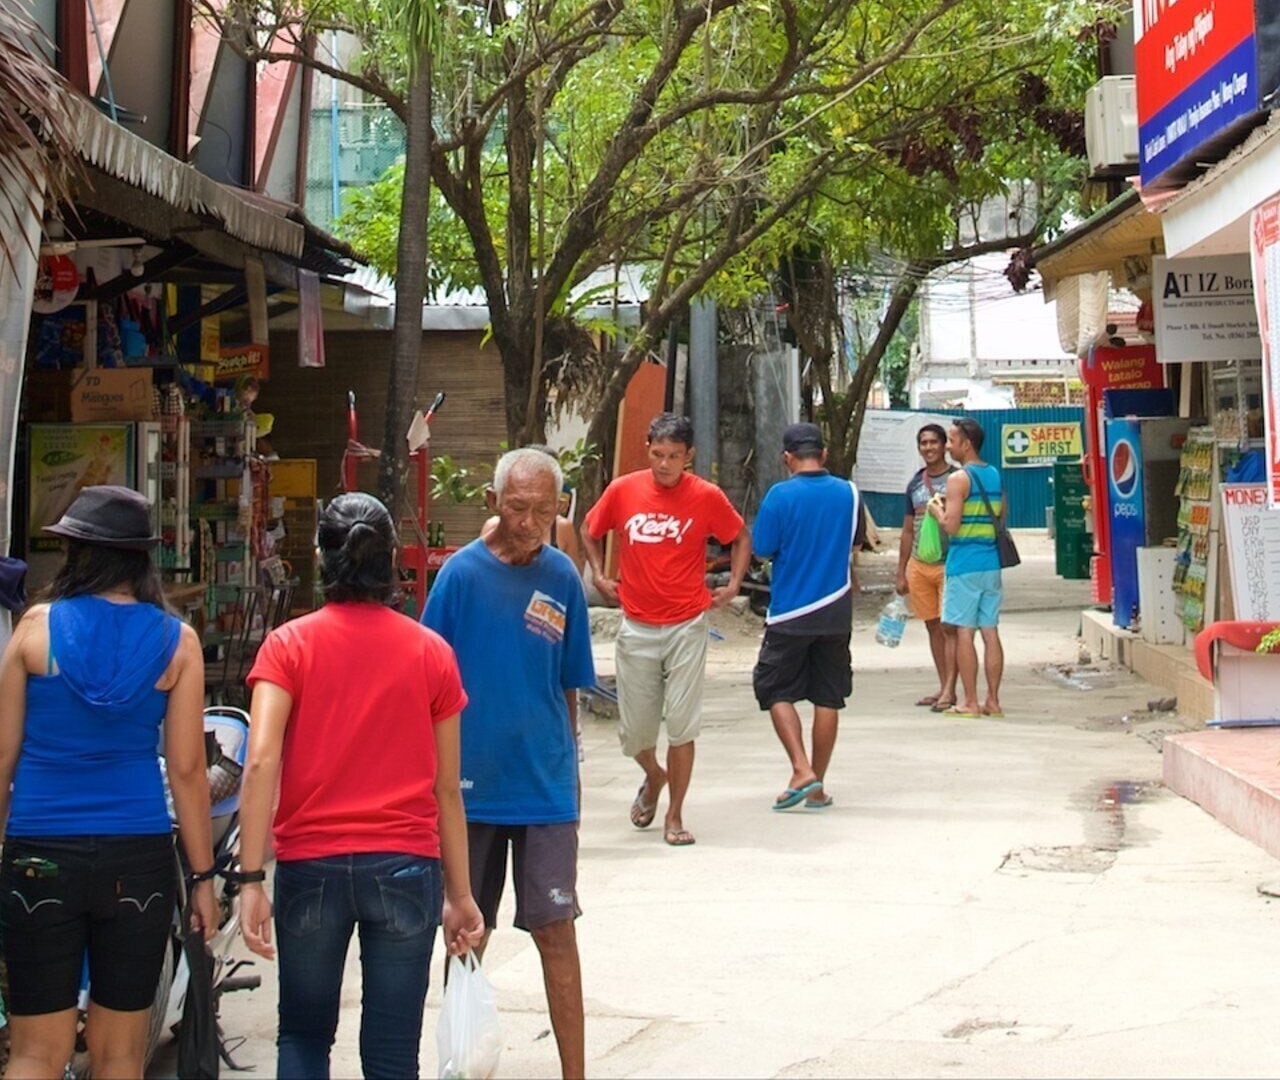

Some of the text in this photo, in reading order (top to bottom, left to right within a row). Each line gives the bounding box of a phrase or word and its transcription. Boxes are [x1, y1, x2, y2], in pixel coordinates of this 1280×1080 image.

[1101, 357, 1146, 371] Walang
[1108, 370, 1142, 382] tatalo
[1031, 427, 1075, 441] SAFETY
[1039, 441, 1072, 454] FIRST
[624, 513, 693, 545] Reds!
